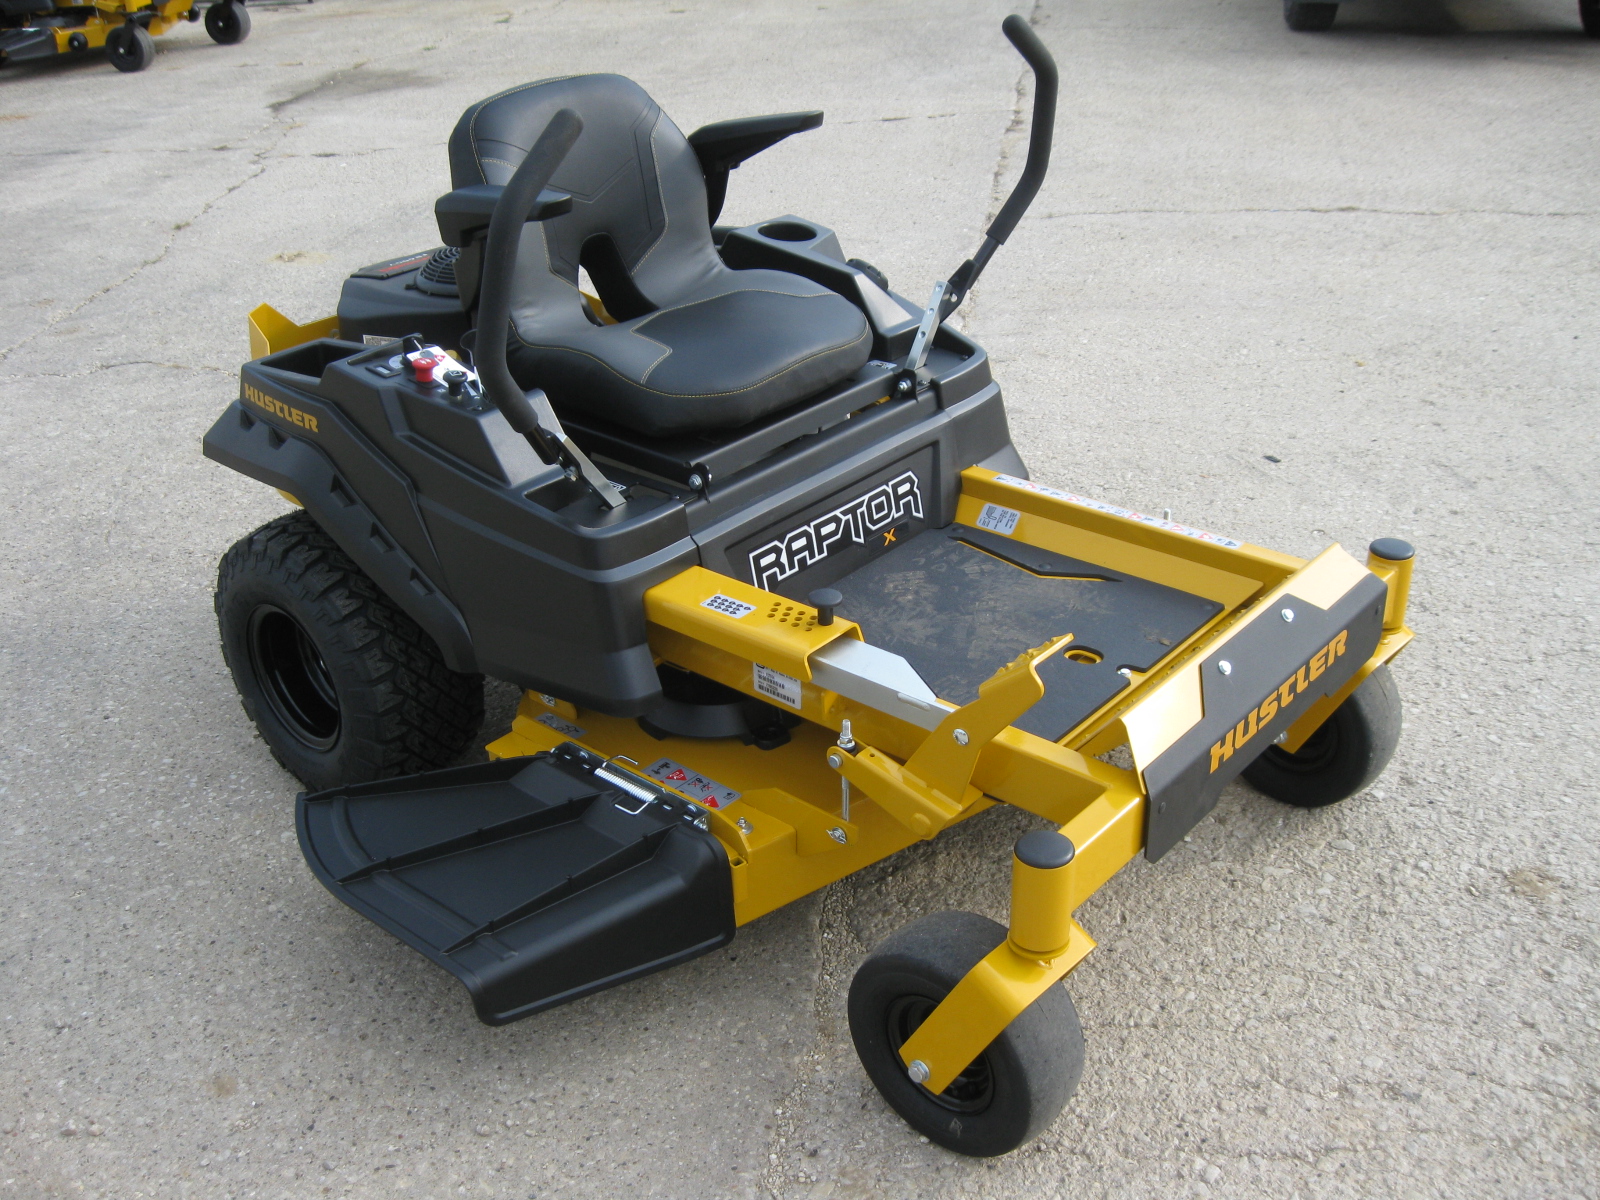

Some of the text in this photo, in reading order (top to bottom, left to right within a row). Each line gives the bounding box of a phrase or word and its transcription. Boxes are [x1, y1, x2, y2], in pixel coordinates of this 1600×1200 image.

[244, 382, 319, 433] HUSTLER
[749, 470, 924, 593] RAPTOR
[1209, 629, 1348, 774] HUSTLER
